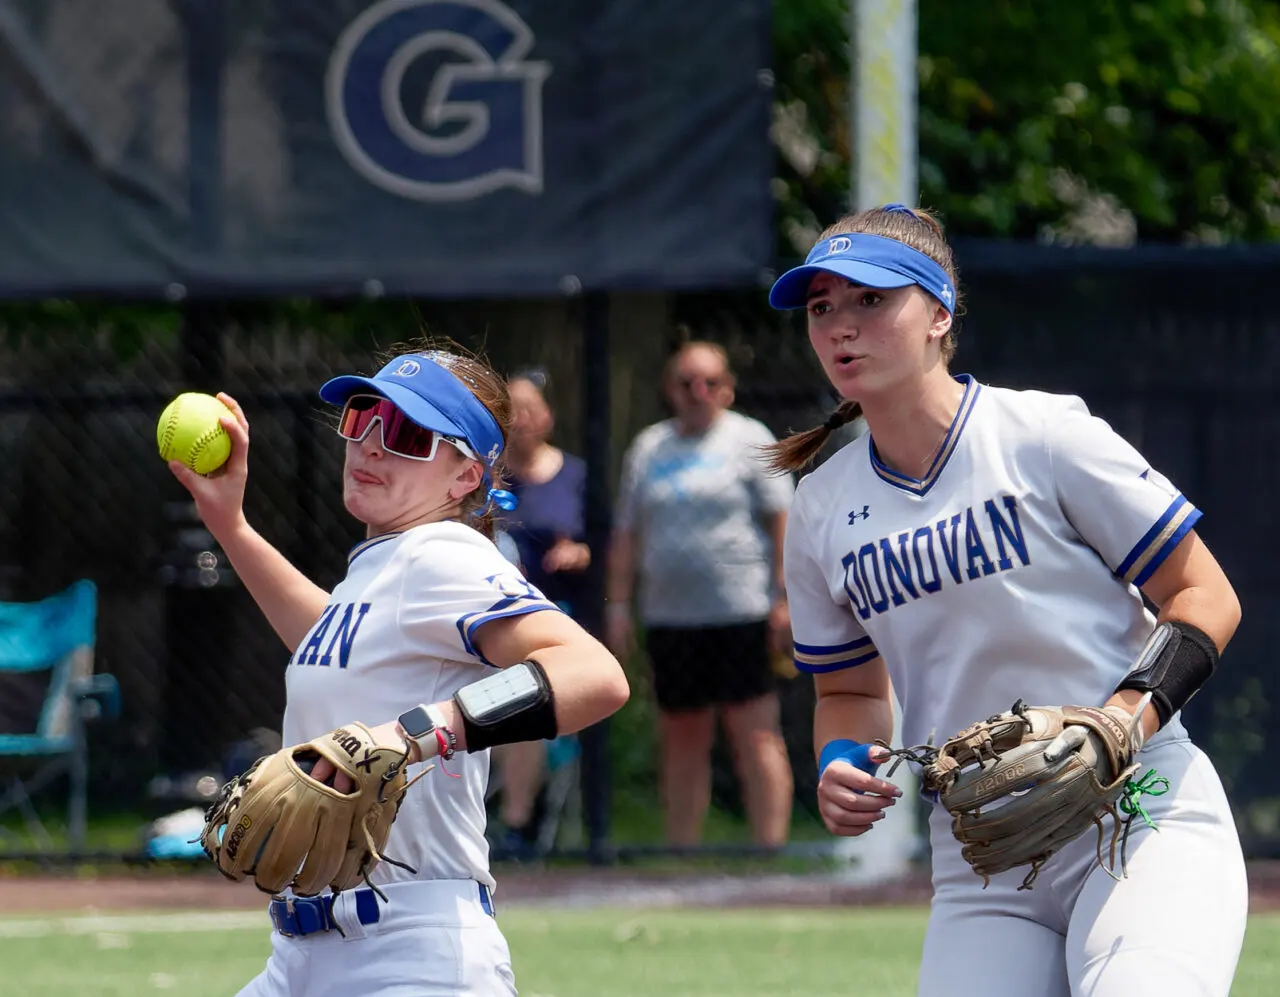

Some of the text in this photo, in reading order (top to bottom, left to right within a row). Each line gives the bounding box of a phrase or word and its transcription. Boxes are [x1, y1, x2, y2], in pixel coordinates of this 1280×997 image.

[324, 0, 552, 202] G
[841, 495, 1032, 621] DONOVAN
[289, 602, 372, 669] AN
